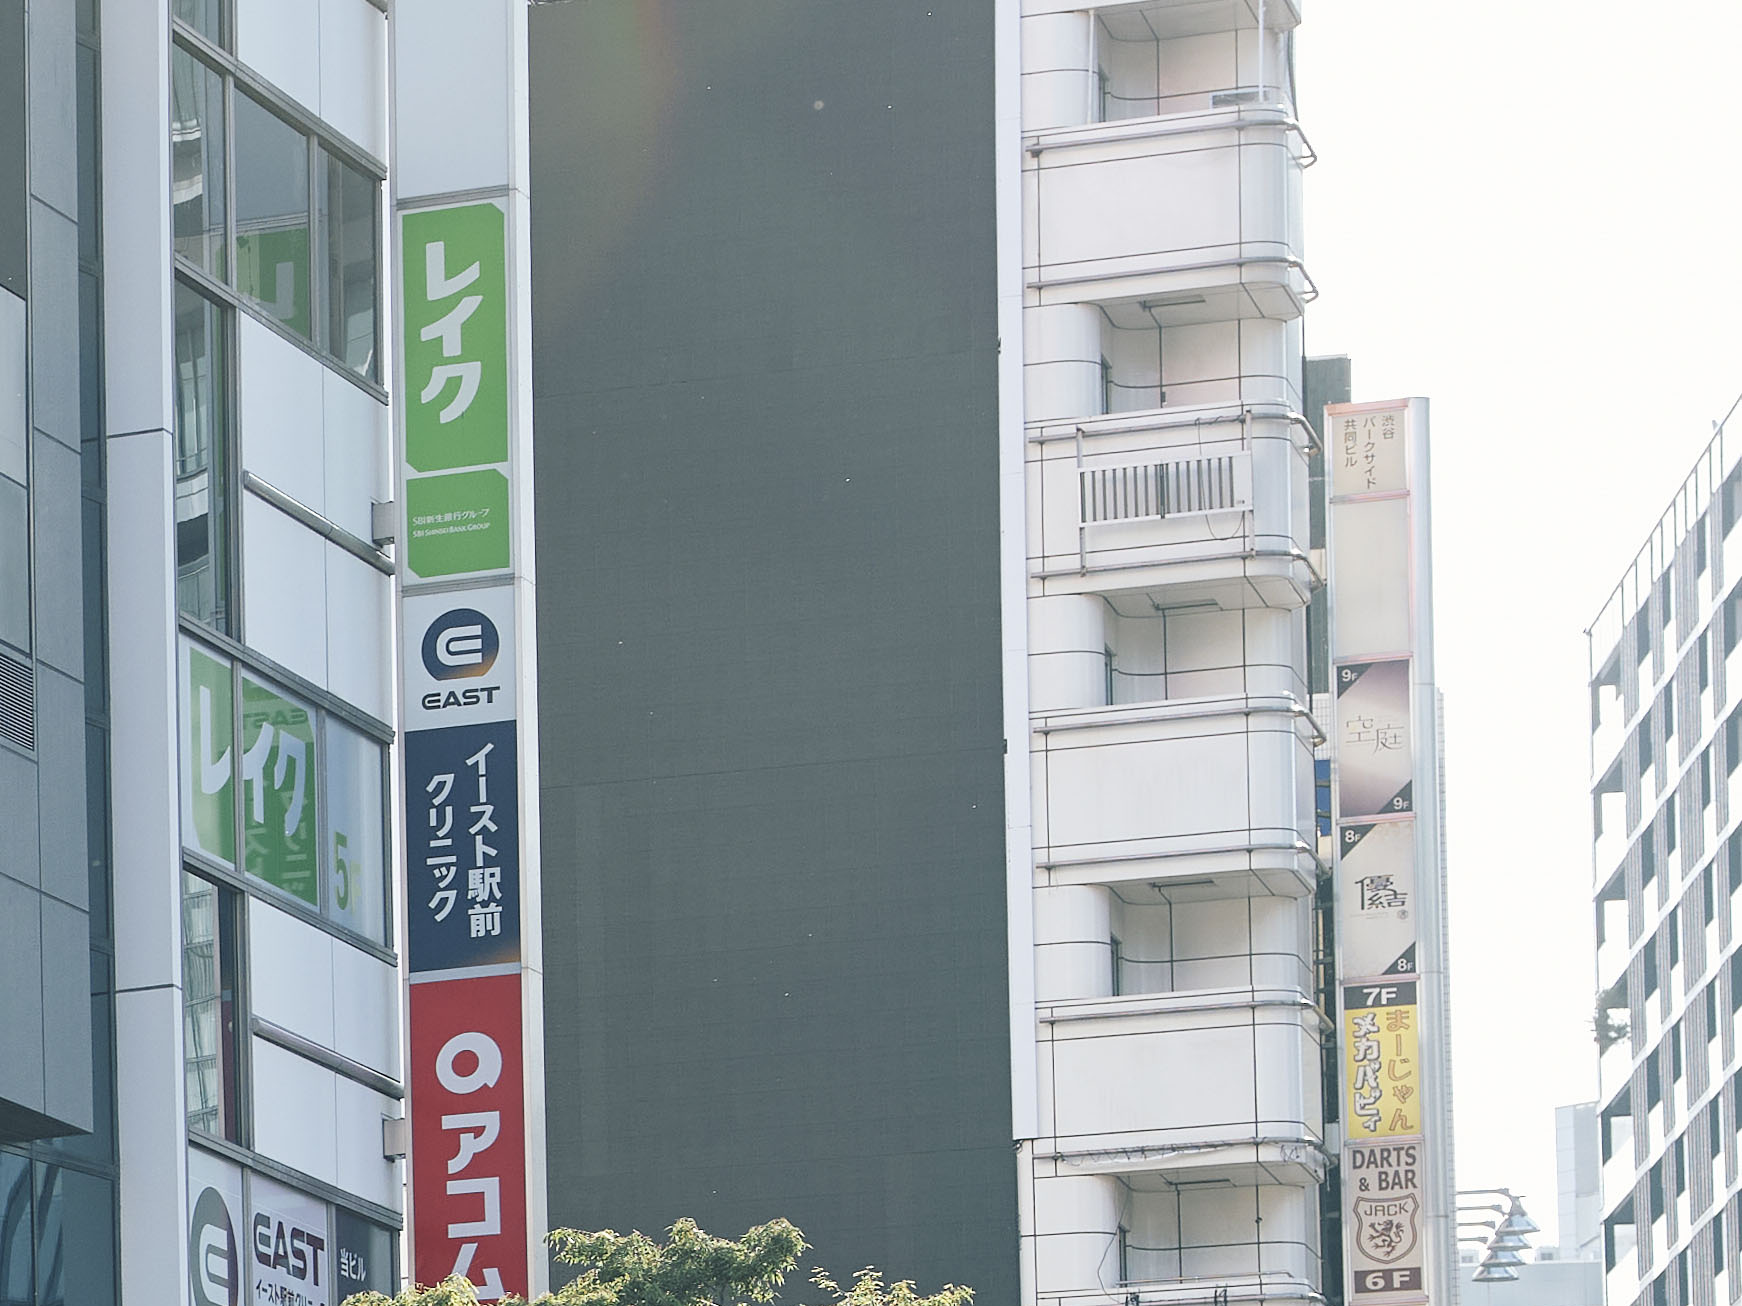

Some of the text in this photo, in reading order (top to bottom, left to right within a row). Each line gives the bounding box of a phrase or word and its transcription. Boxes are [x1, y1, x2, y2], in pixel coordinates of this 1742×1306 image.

[419, 240, 484, 424] レイク
[1382, 415, 1395, 440] 渋谷
[1344, 419, 1357, 468] 共同ビル
[1363, 416, 1376, 489] パークサイド
[1342, 669, 1358, 682] 9F
[421, 686, 501, 711] EAST
[199, 685, 307, 838] レイク
[1393, 797, 1409, 810] 9F
[425, 773, 458, 922] クリニック
[465, 742, 503, 937] イースト駅前
[1345, 830, 1361, 843] 8F
[1397, 958, 1414, 971] 8F
[1363, 987, 1398, 1006] 7F
[1386, 1009, 1414, 1131] まーじゃん
[1352, 1146, 1417, 1170] DARTS
[1359, 1169, 1418, 1192] & BAR
[440, 1112, 506, 1303] アコム
[1364, 1201, 1409, 1217] JACK
[253, 1212, 325, 1287] EAST
[340, 1247, 367, 1282] 当ビル
[1365, 1270, 1411, 1291] 6F
